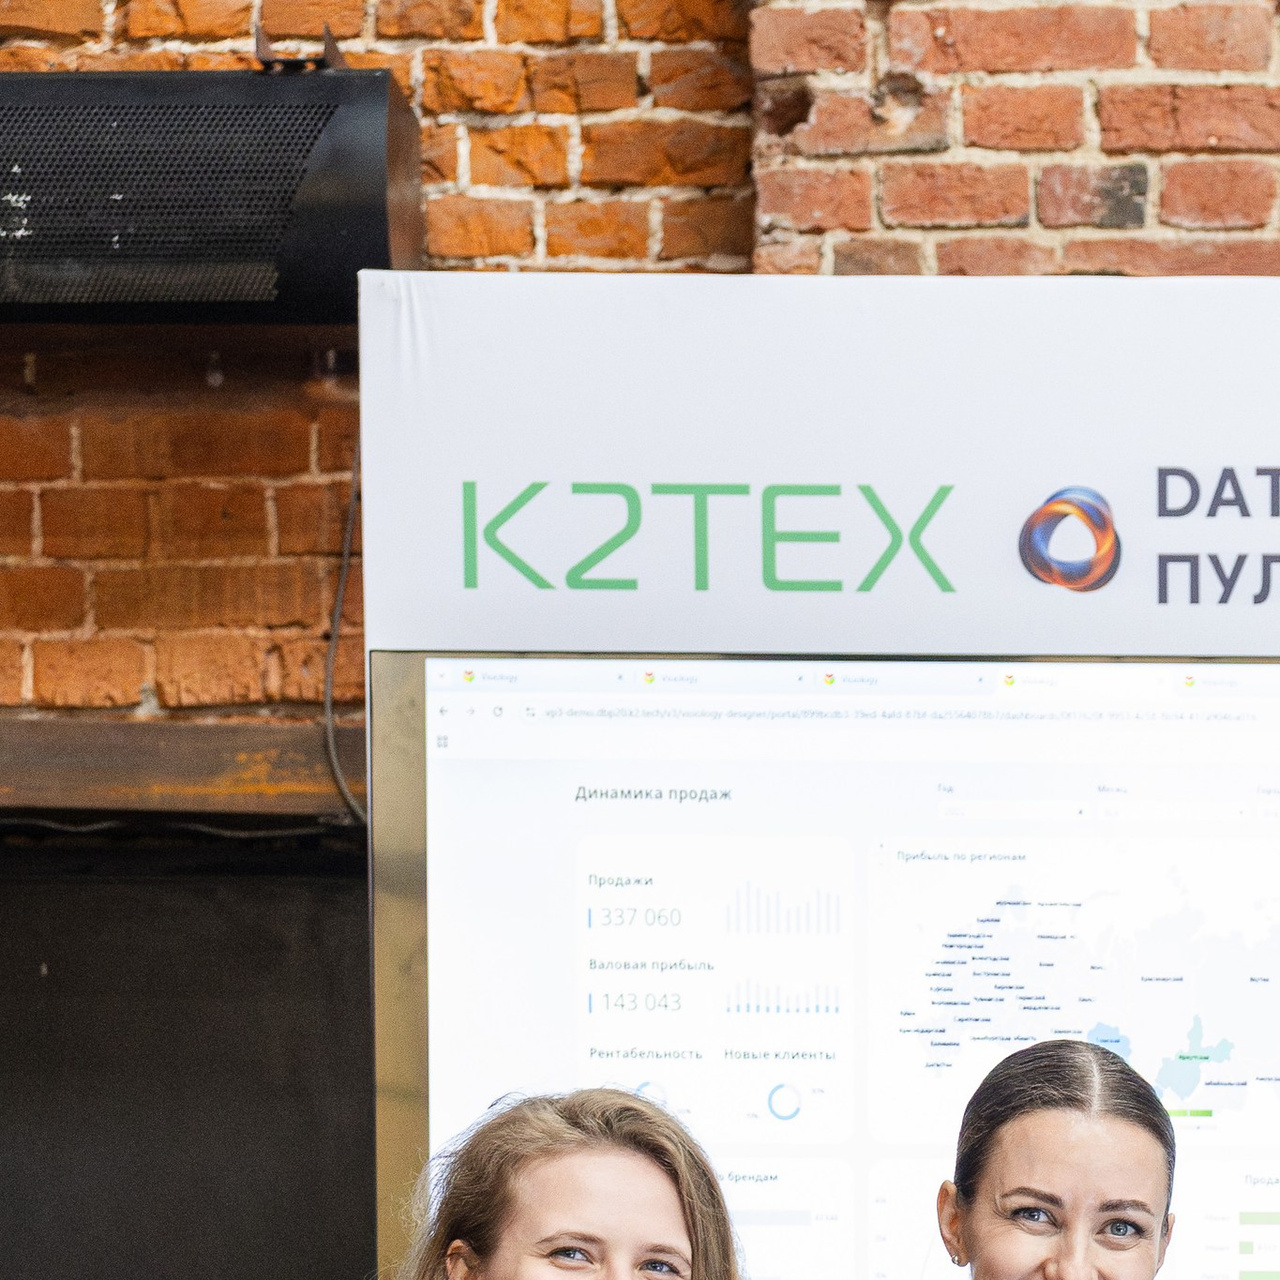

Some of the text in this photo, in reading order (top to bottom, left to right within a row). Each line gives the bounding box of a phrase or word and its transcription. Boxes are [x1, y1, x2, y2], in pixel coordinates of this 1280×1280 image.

[575, 785, 732, 804] Динамика продаж
[589, 874, 653, 888] Продажи
[602, 908, 681, 926] 337 060
[589, 958, 714, 972] Валовая прибыль
[603, 993, 681, 1011] 143 043
[590, 1048, 702, 1059] Рентабельность
[724, 1048, 836, 1060] Новые клиенты
